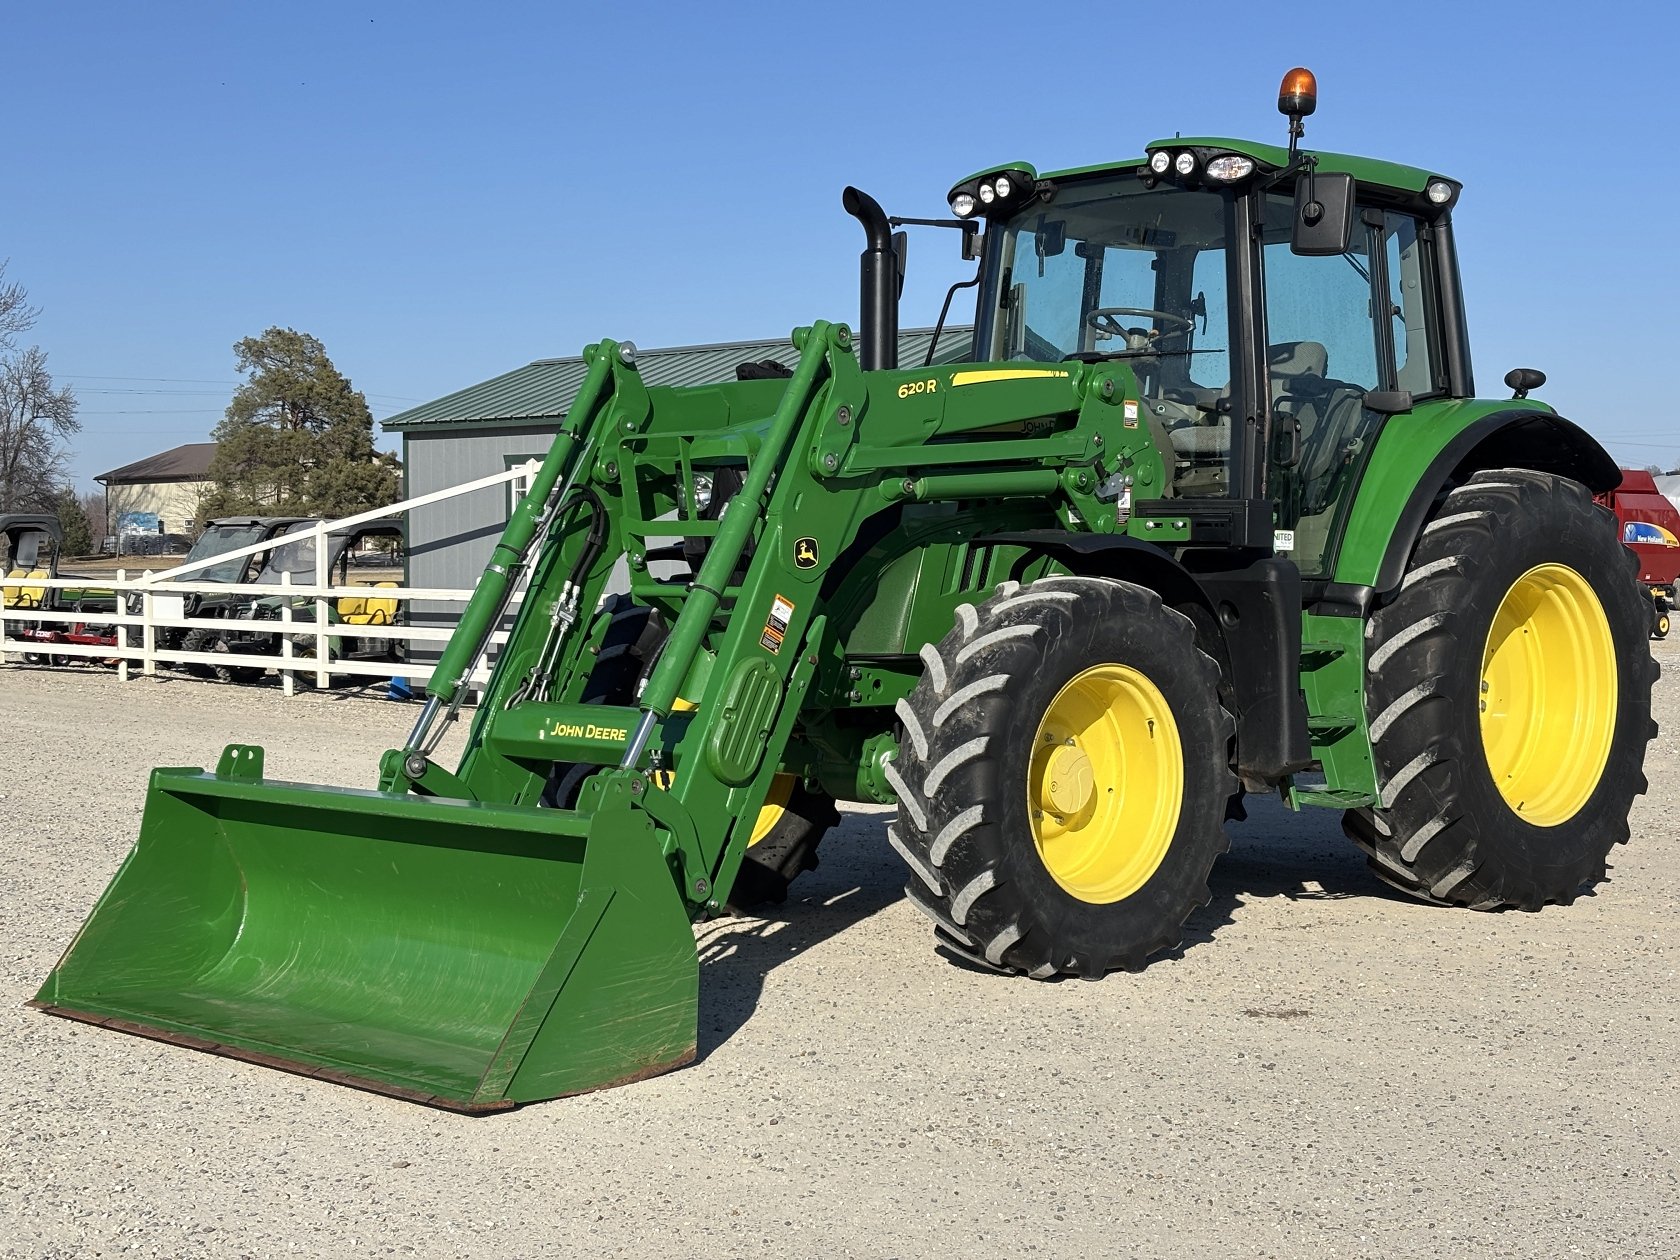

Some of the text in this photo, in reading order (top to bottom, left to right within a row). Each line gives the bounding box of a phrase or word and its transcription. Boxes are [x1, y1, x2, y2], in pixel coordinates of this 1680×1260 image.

[898, 379, 937, 399] 620 R
[1637, 534, 1648, 542] New
[550, 722, 627, 741] JOHN DEERE
